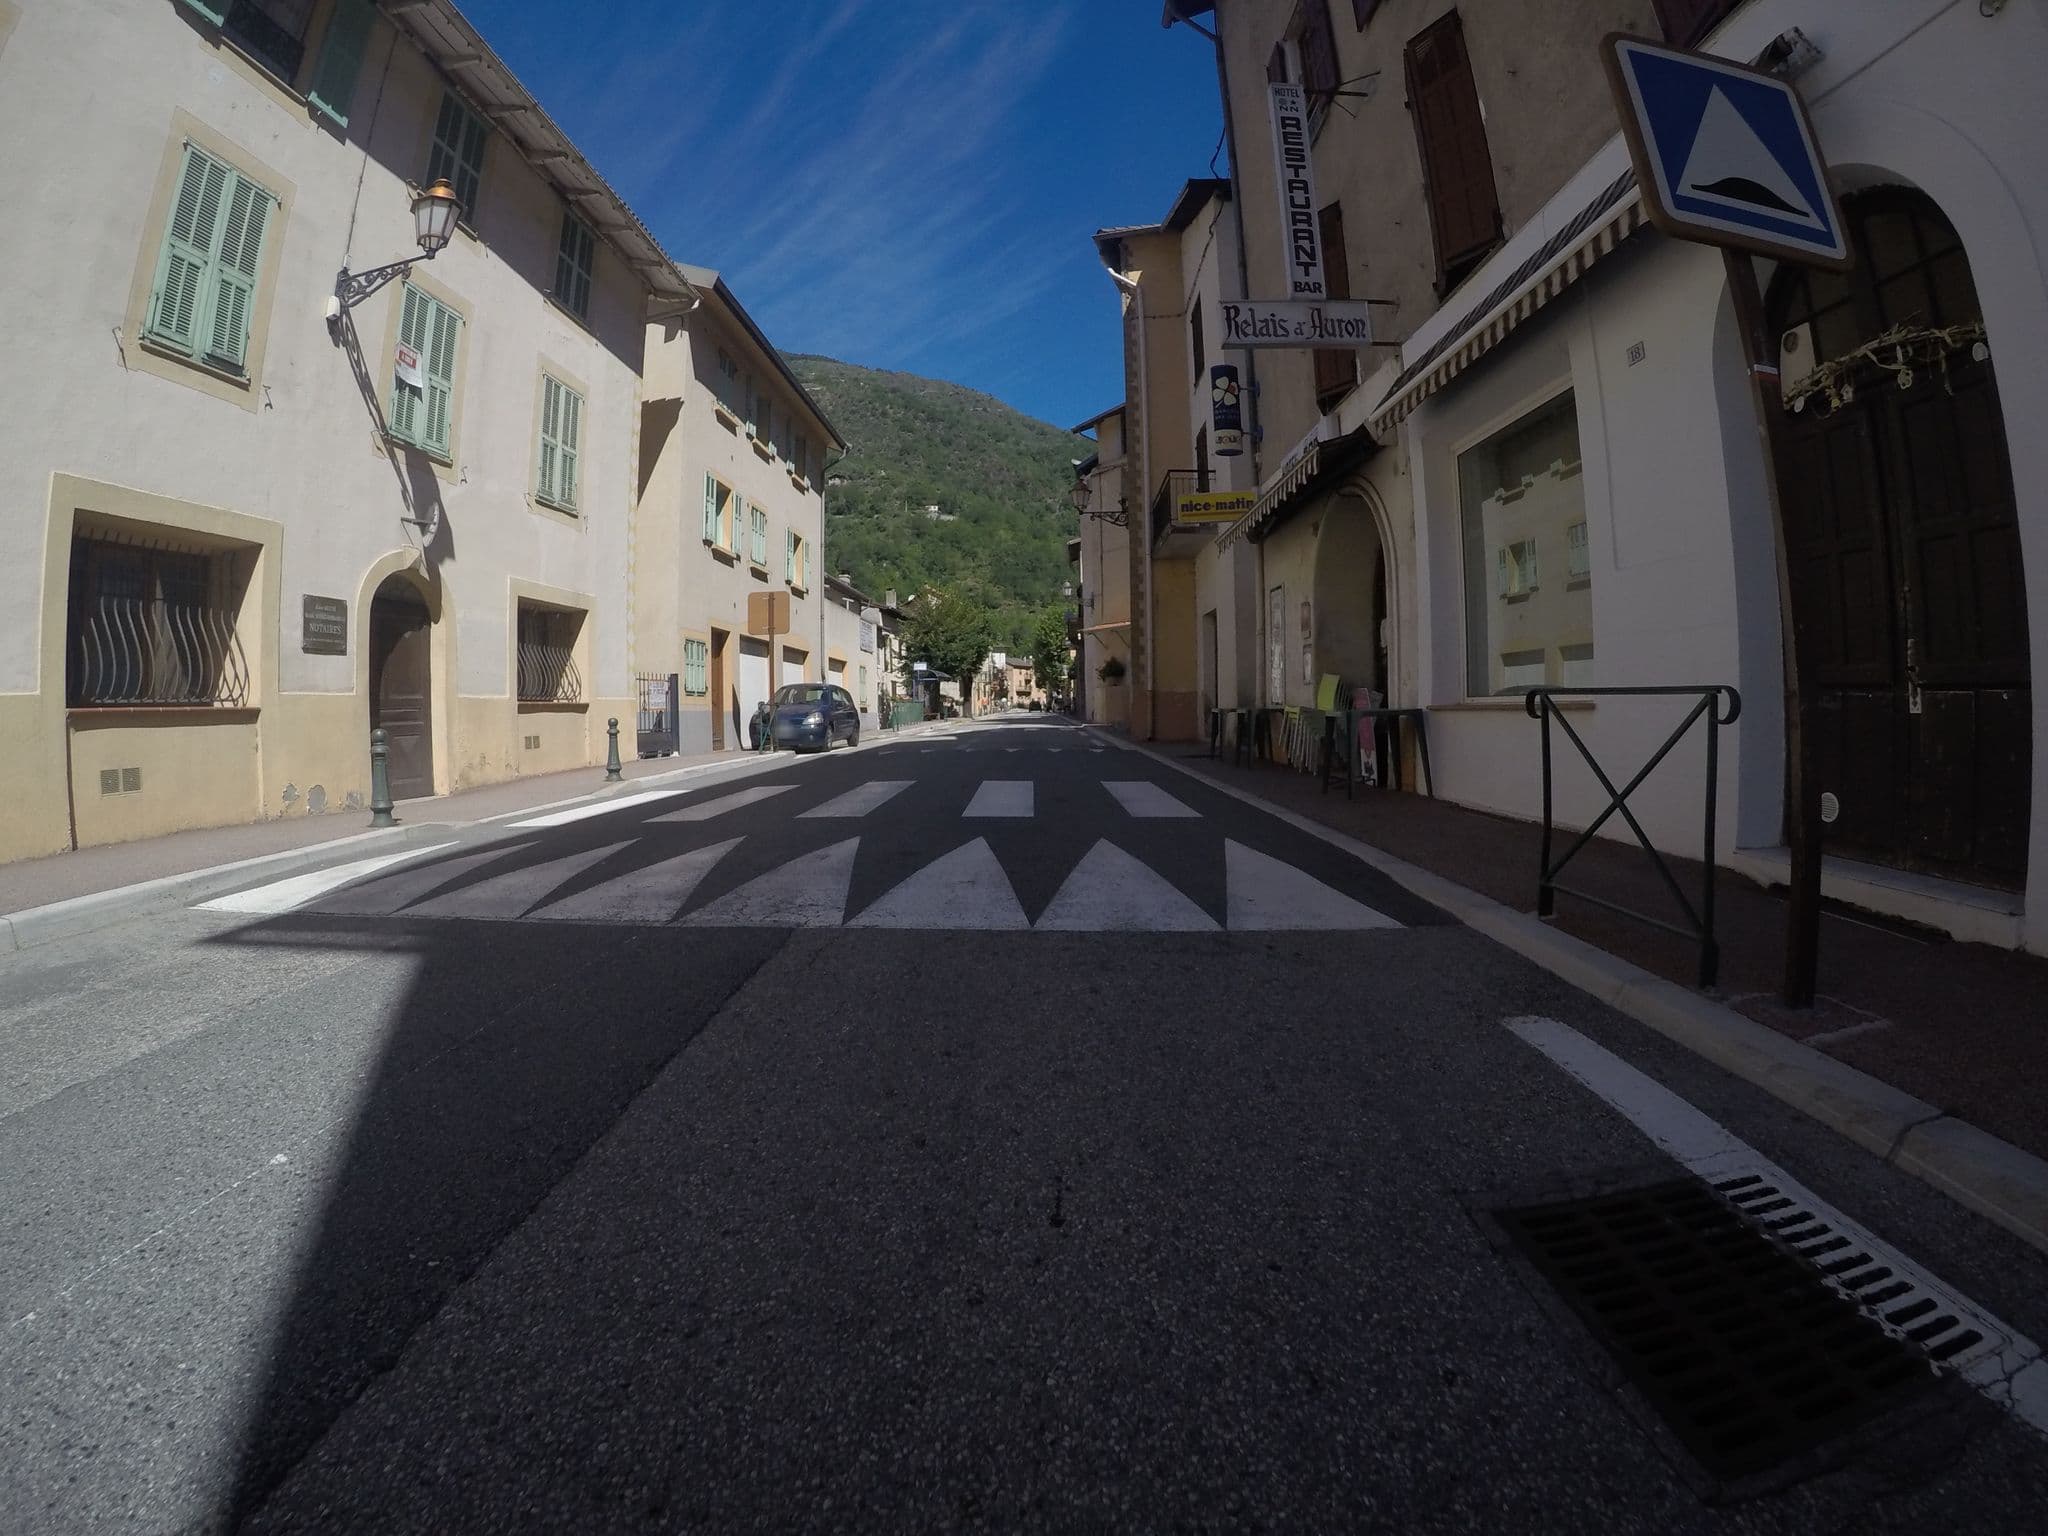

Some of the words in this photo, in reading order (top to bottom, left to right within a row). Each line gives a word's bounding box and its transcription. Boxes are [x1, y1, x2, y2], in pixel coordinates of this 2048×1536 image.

[1274, 87, 1300, 98] HOTEL
[1280, 116, 1317, 277] RESTAURANT
[1293, 281, 1323, 294] BAR
[1223, 305, 1290, 341] Relais
[1630, 346, 1641, 362] 18
